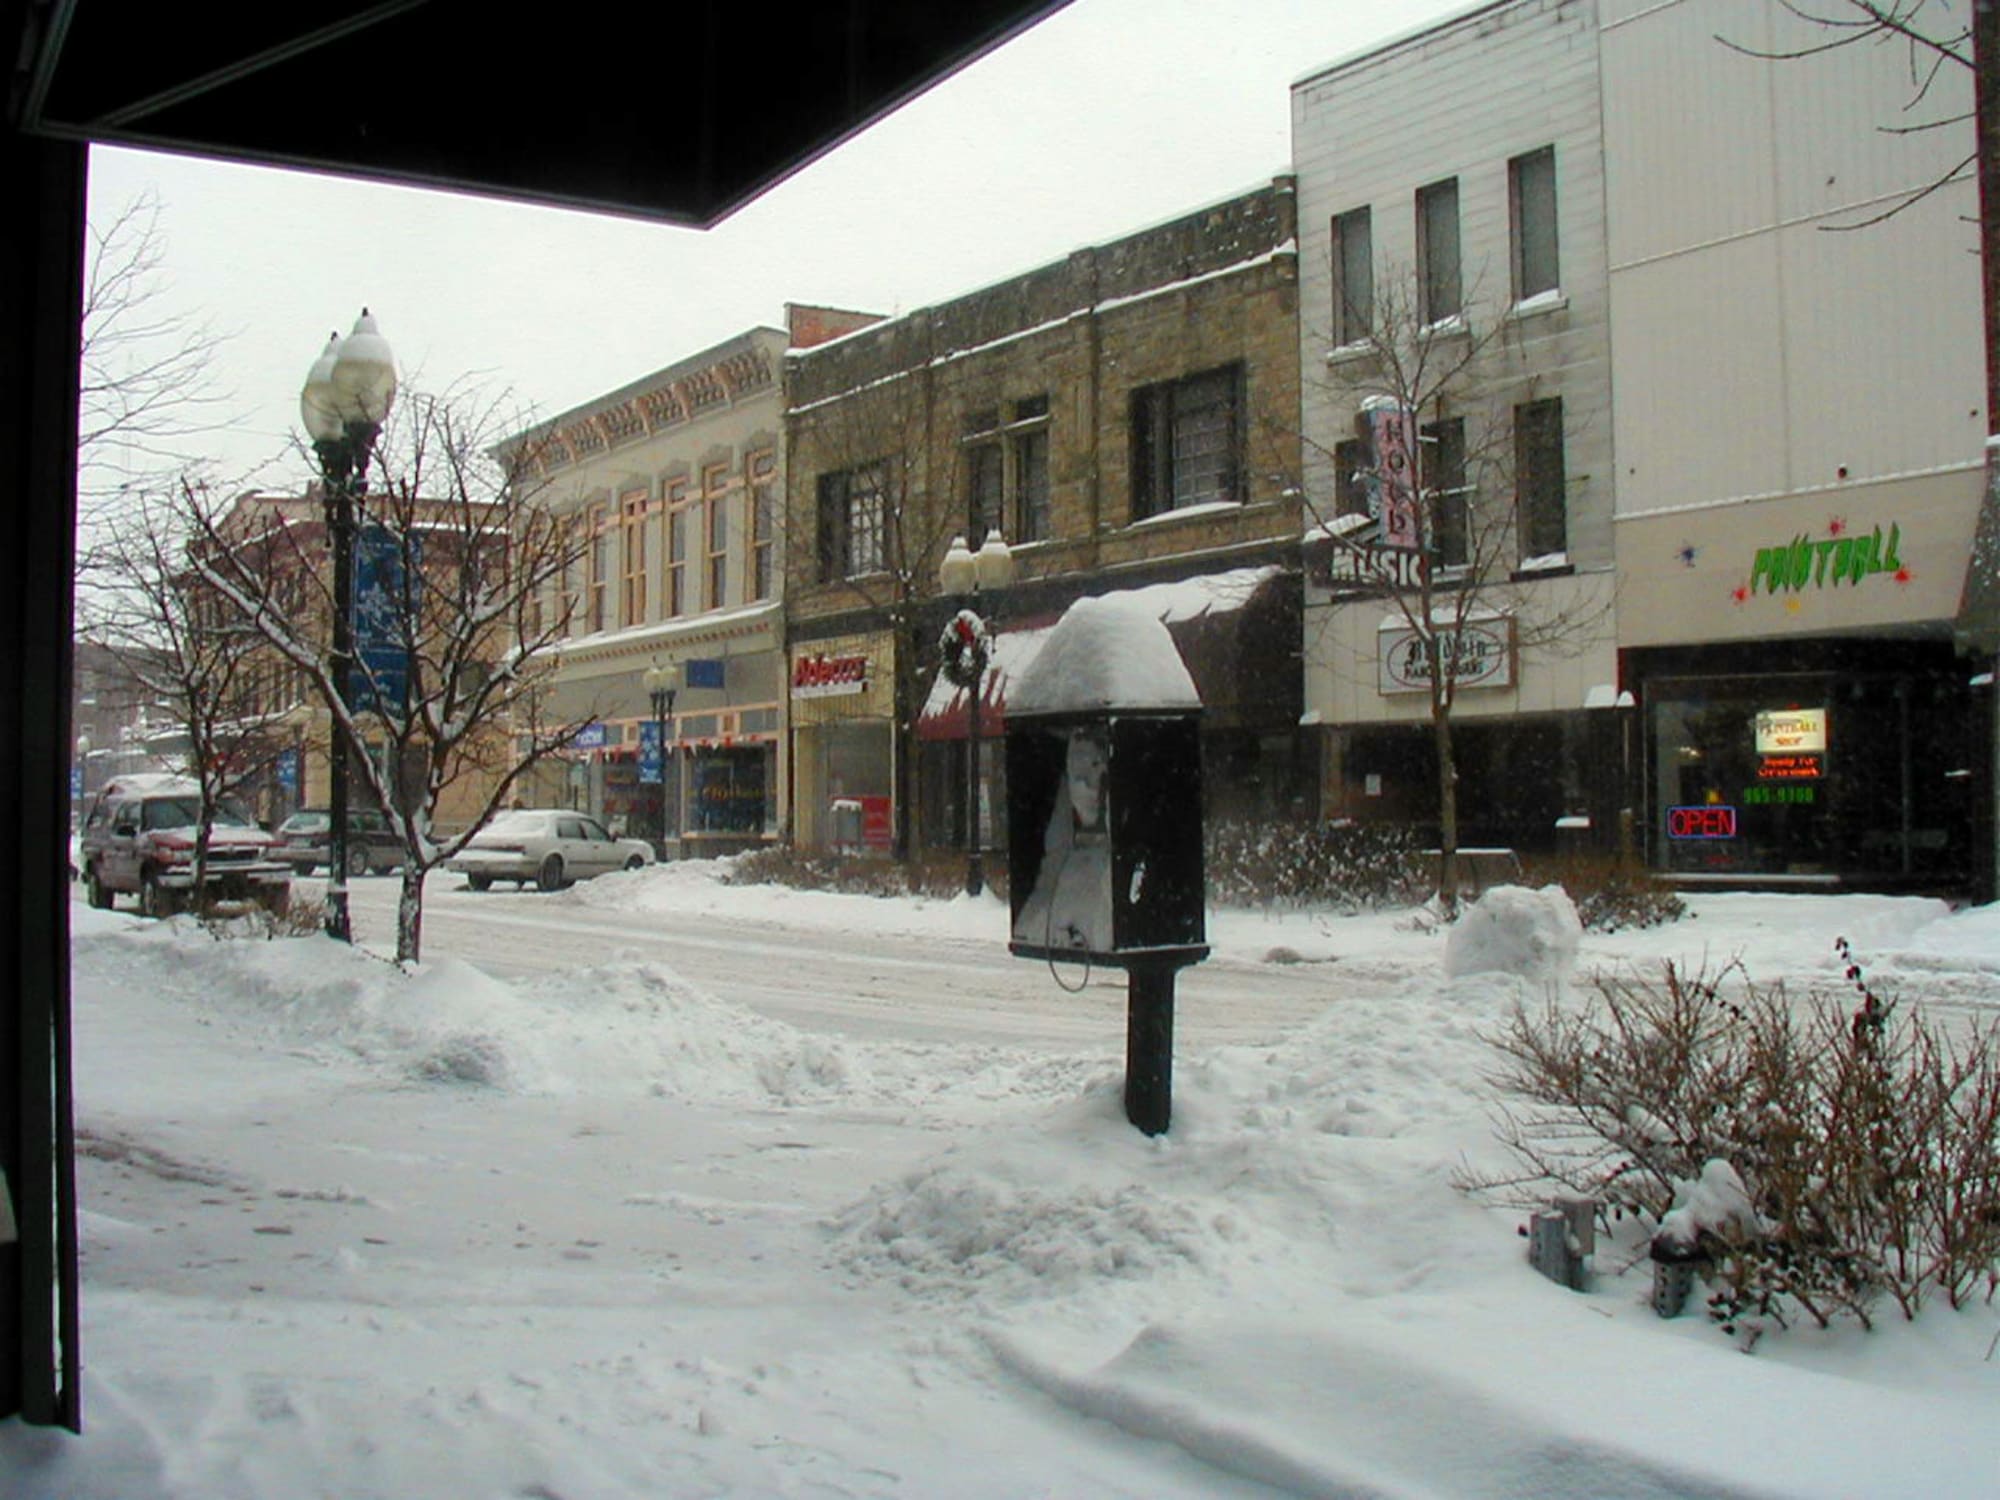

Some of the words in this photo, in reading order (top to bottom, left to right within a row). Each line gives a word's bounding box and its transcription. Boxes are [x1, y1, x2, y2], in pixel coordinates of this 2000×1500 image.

[1332, 546, 1424, 589] MUSIC
[1750, 520, 1899, 595] PAINTBALL
[1671, 808, 1734, 837] OPEN
